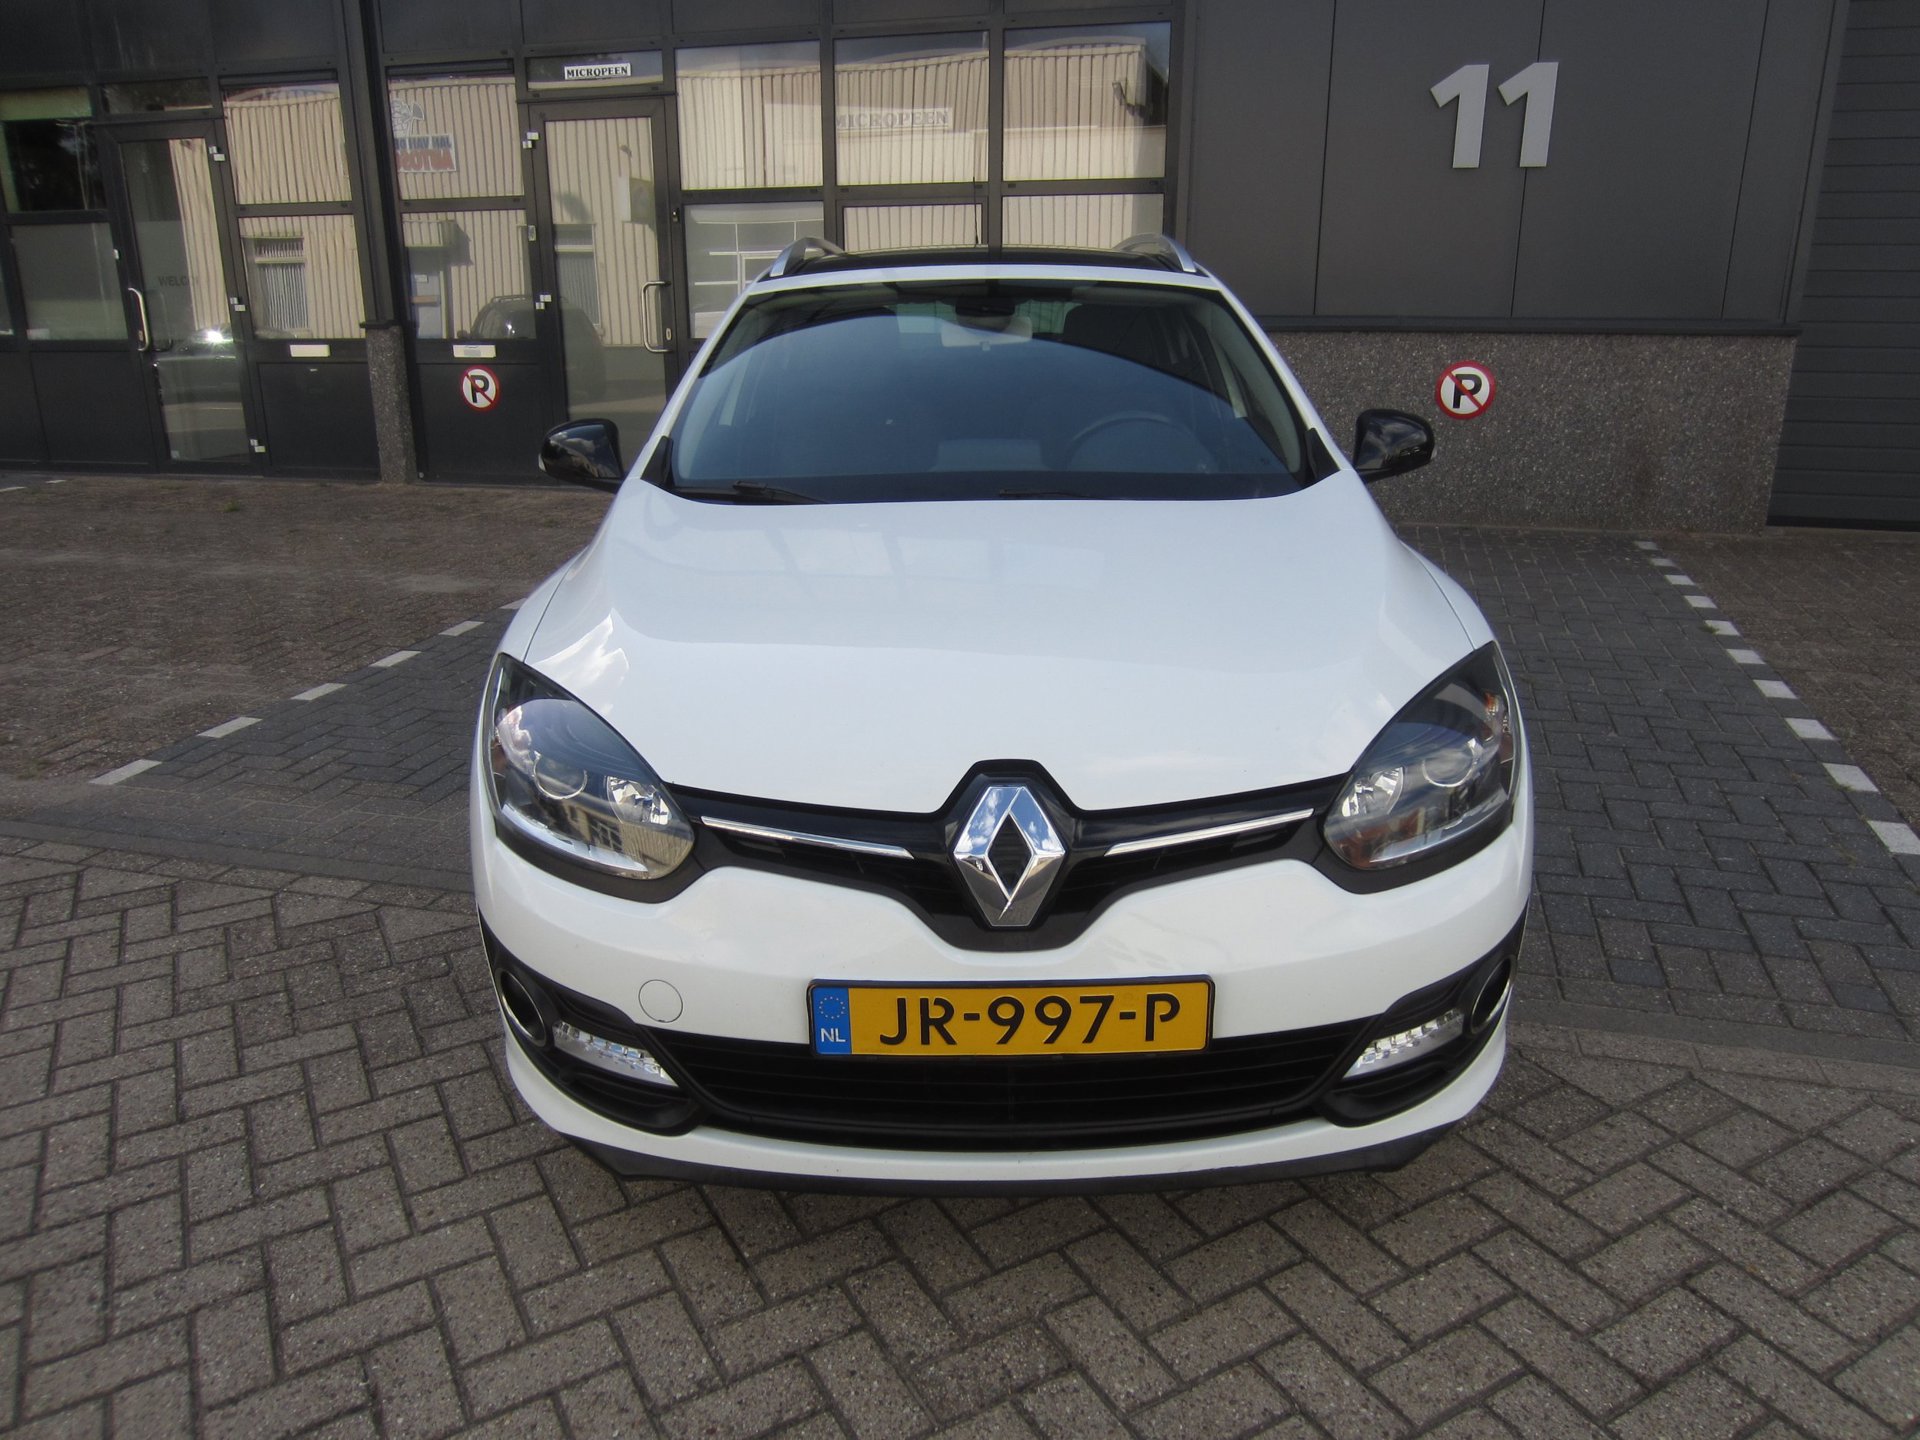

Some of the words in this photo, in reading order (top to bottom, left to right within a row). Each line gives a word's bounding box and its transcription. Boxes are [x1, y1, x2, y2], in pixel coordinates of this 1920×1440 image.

[566, 66, 628, 77] MICROPEEN
[836, 110, 950, 129] MICROPEEN
[1430, 62, 1559, 168] 11
[879, 992, 1181, 1047] JR-997-P
[820, 1027, 847, 1043] NL
